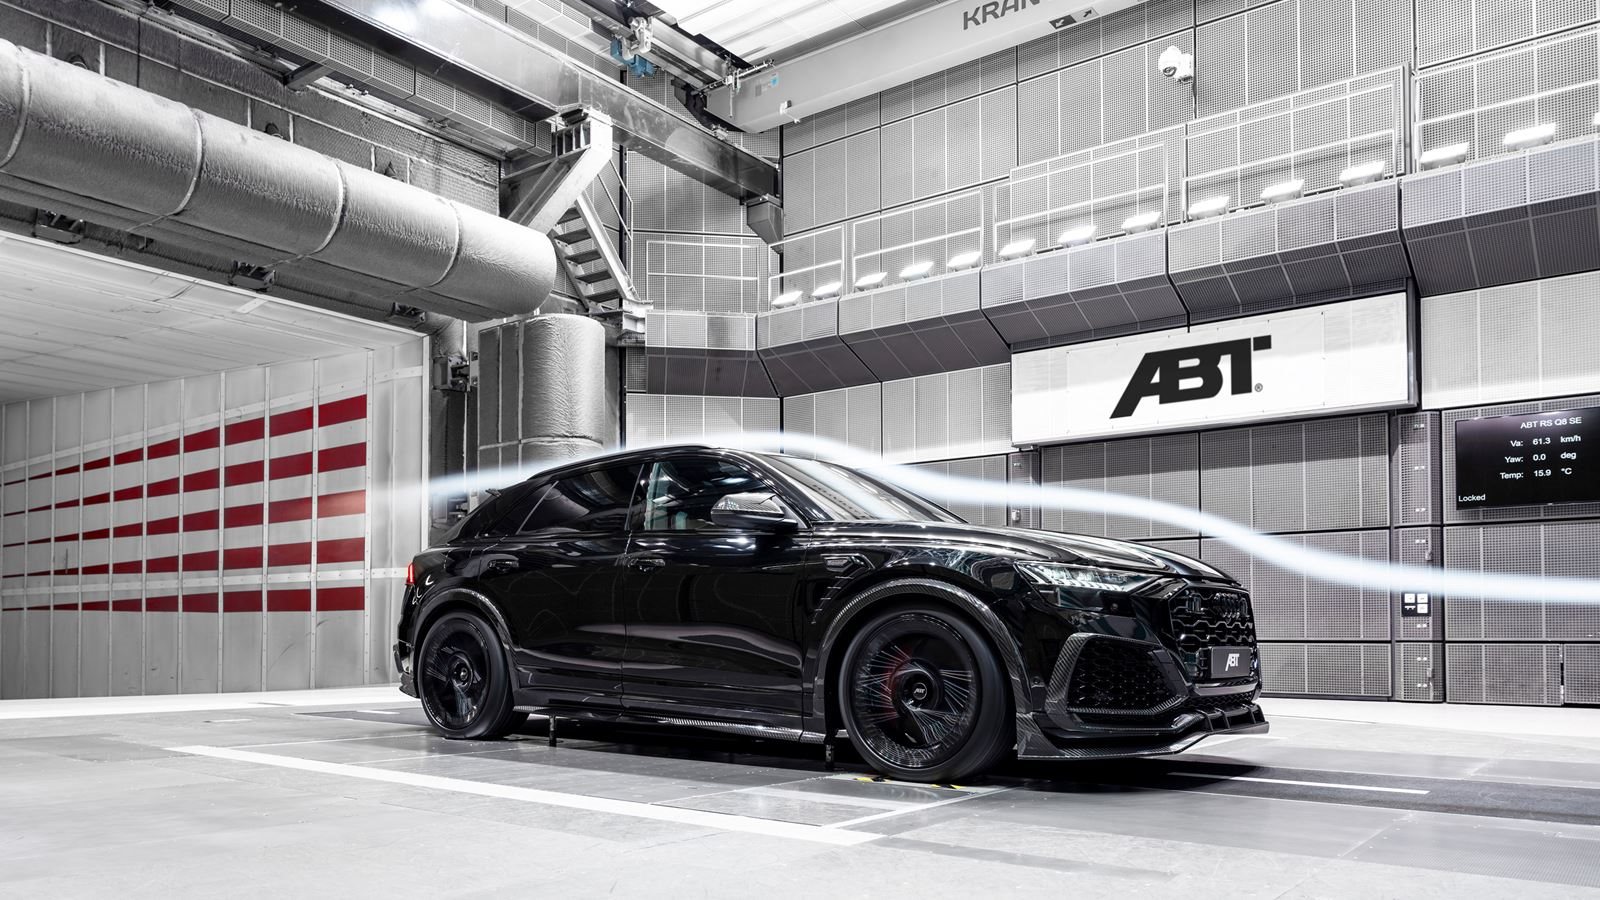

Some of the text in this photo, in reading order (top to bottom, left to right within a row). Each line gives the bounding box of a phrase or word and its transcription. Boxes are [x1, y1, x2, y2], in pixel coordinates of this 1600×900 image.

[1520, 420, 1538, 429] ABT
[1540, 419, 1553, 427] RS
[1554, 418, 1567, 426] Q8
[1532, 437, 1551, 445] 61.3
[1560, 435, 1581, 443] km/h
[1532, 453, 1546, 461] 0.0
[1560, 451, 1576, 460] deg
[1500, 472, 1523, 480] Temp:
[1533, 469, 1551, 477] 15.9
[1458, 494, 1485, 502] Locked
[1225, 653, 1240, 671] ABT
